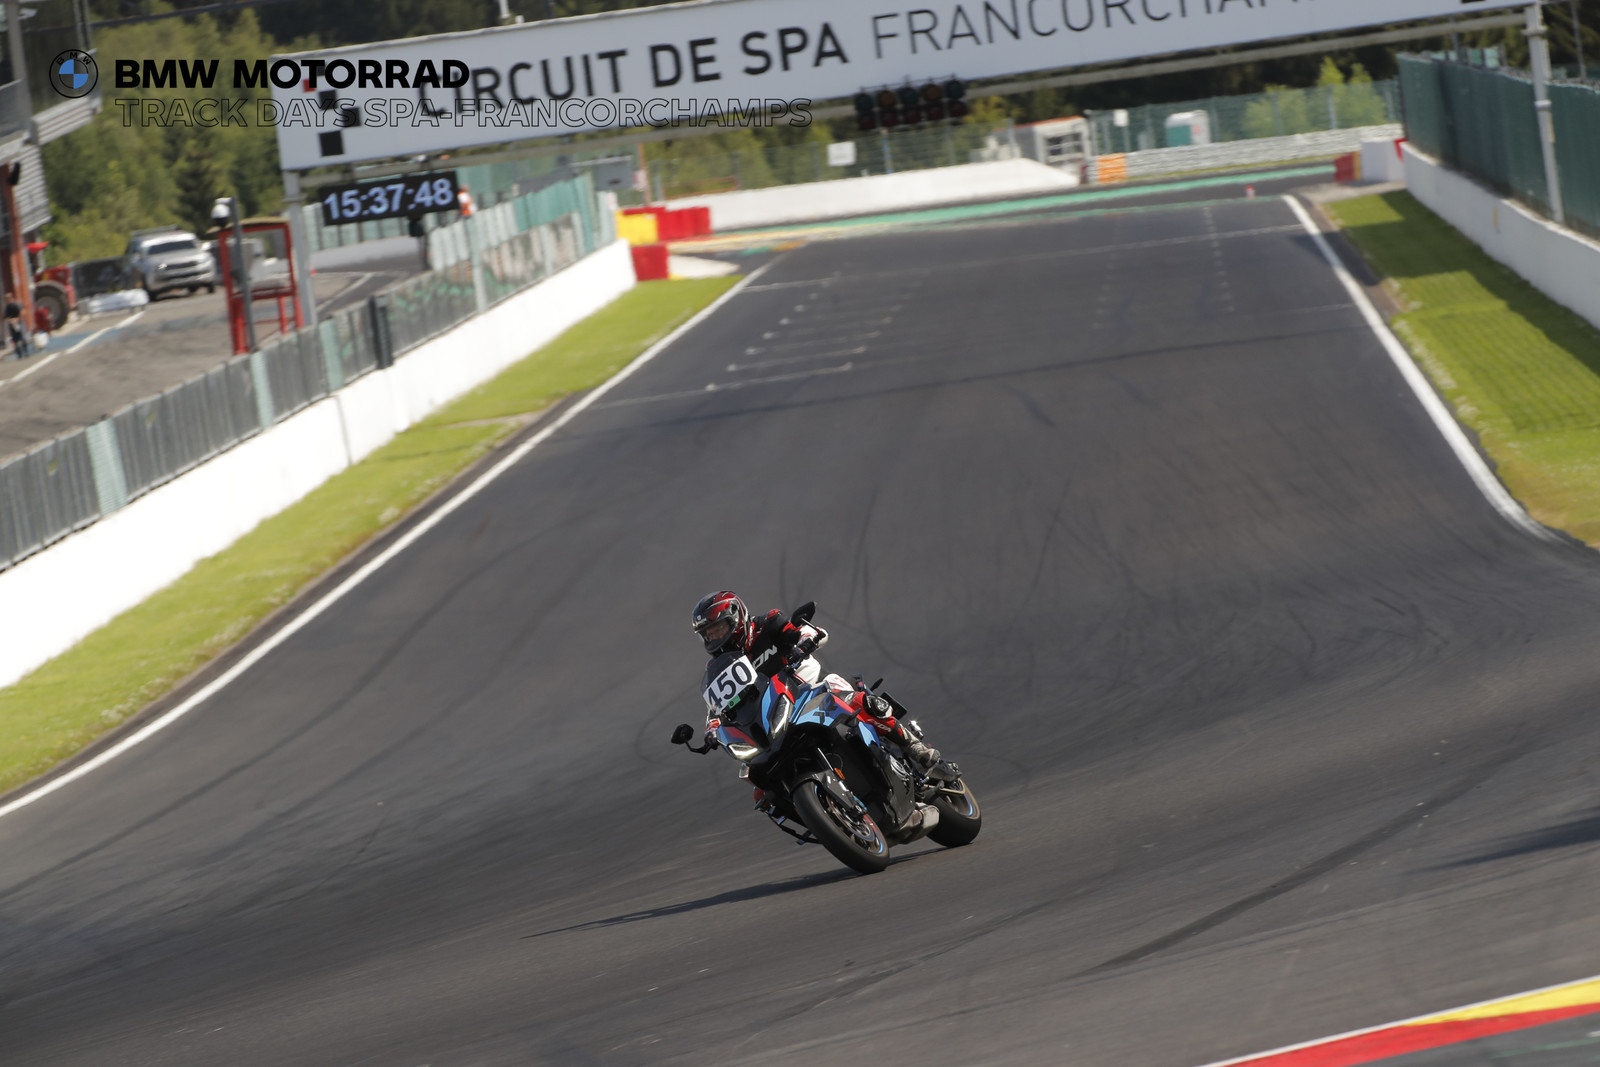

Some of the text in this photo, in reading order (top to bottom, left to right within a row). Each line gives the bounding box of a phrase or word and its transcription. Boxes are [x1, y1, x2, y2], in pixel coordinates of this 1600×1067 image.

[418, 49, 628, 117] CIRCUIT
[649, 37, 722, 88] DE
[741, 22, 850, 76] SPA
[324, 178, 454, 221] 15:37:48
[707, 661, 752, 709] 450
